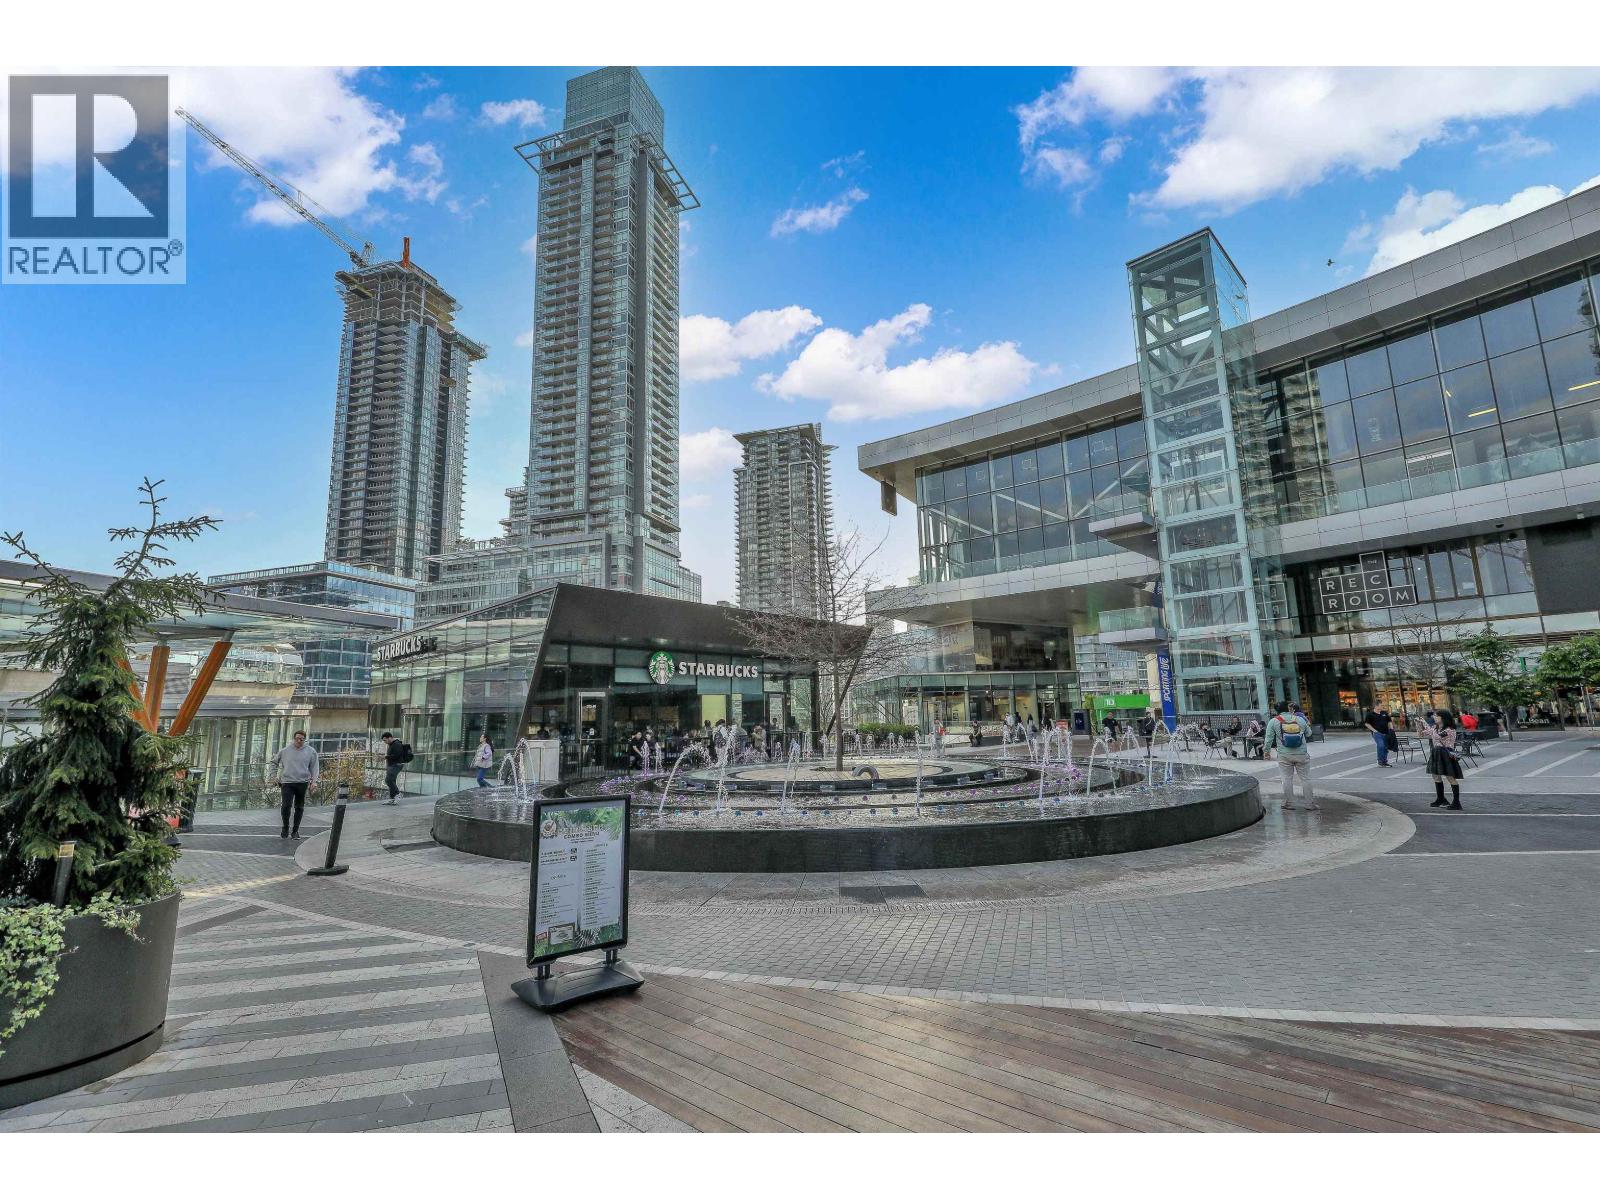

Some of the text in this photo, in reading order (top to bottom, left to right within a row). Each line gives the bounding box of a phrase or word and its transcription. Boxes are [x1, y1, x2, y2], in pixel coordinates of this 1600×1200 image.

[1326, 575, 1382, 591] REC
[1328, 590, 1410, 609] ROOM
[376, 636, 421, 661] STARBUCKS
[678, 661, 759, 678] STARBUCKS
